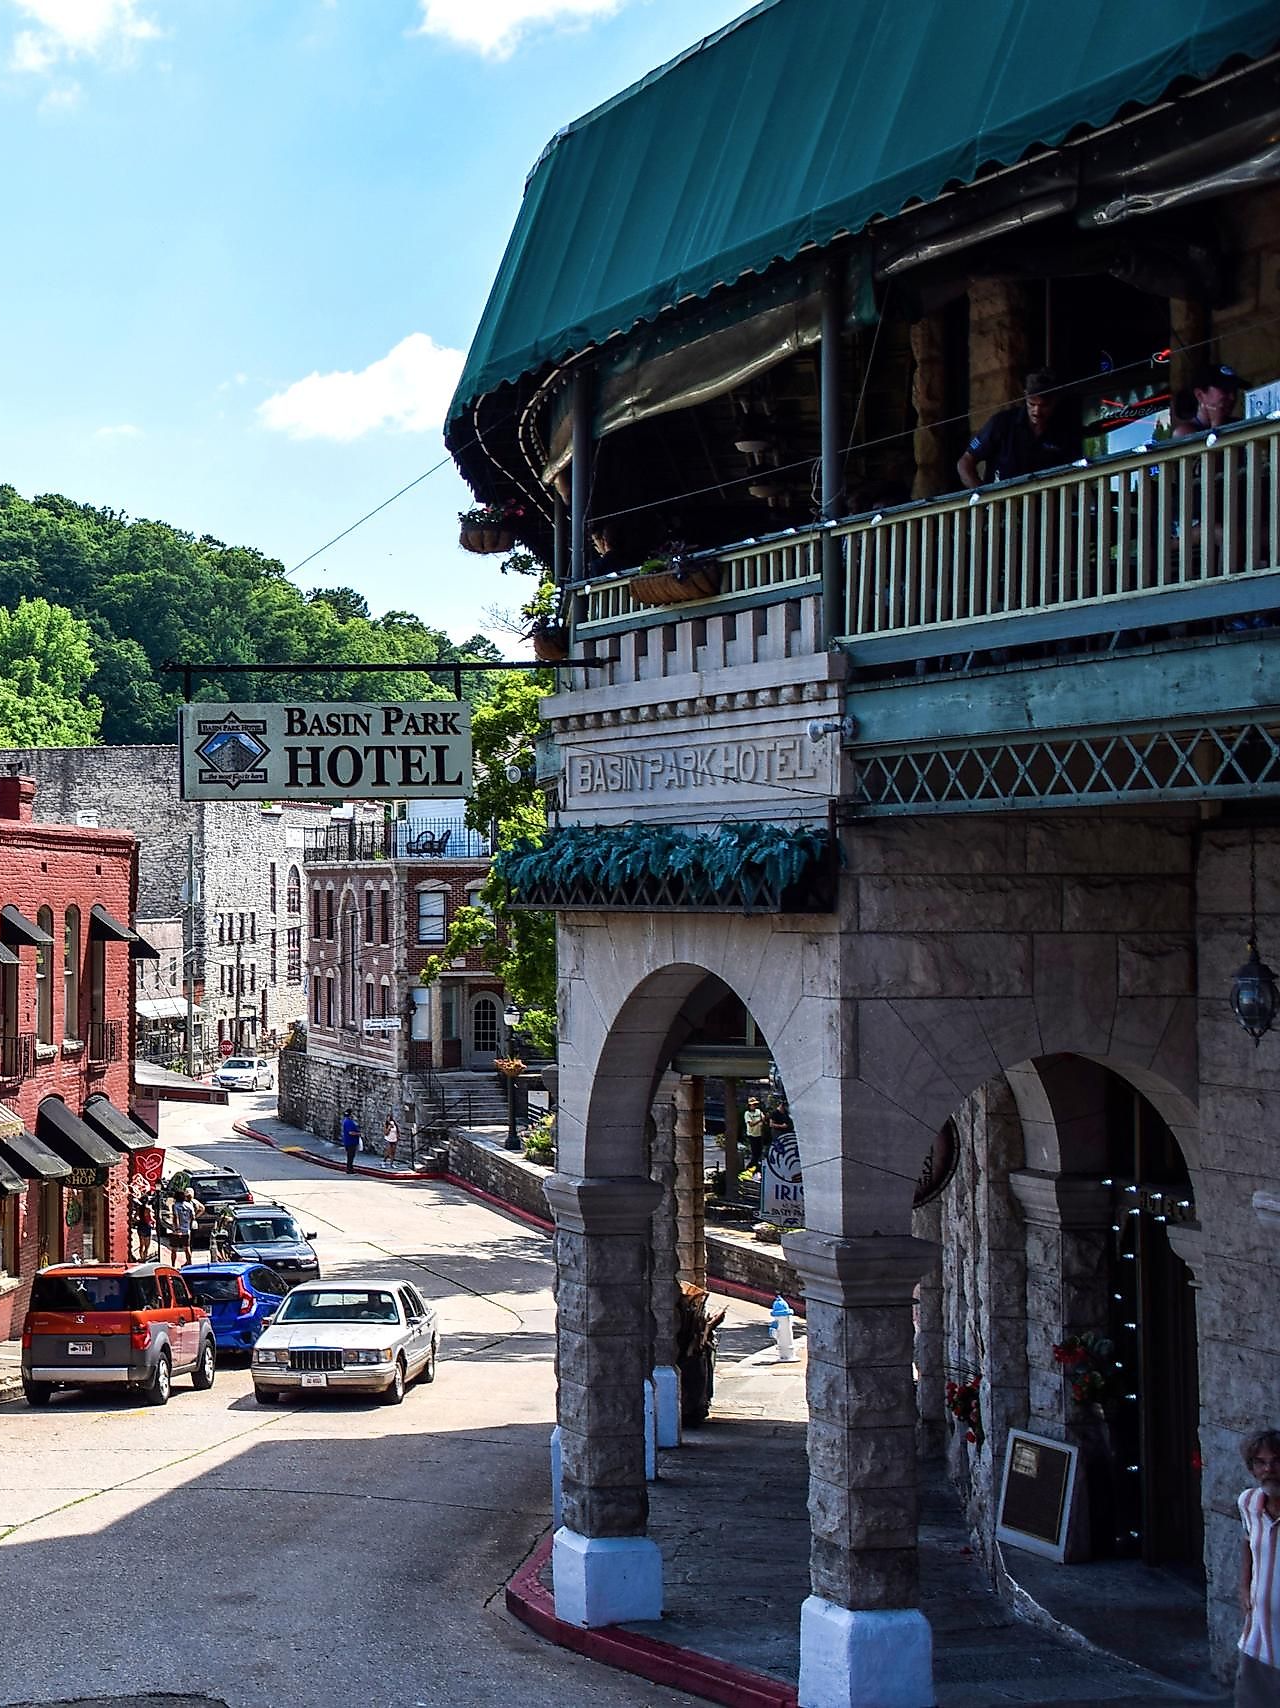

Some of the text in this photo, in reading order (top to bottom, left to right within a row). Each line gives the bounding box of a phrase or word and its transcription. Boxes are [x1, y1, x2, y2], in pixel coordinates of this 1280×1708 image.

[284, 706, 462, 736] BASIN PARK
[284, 745, 463, 788] HOTEL
[579, 739, 816, 793] BASIN PARK HOTEL
[65, 1175, 96, 1185] SHOP
[72, 1167, 97, 1177] OWN
